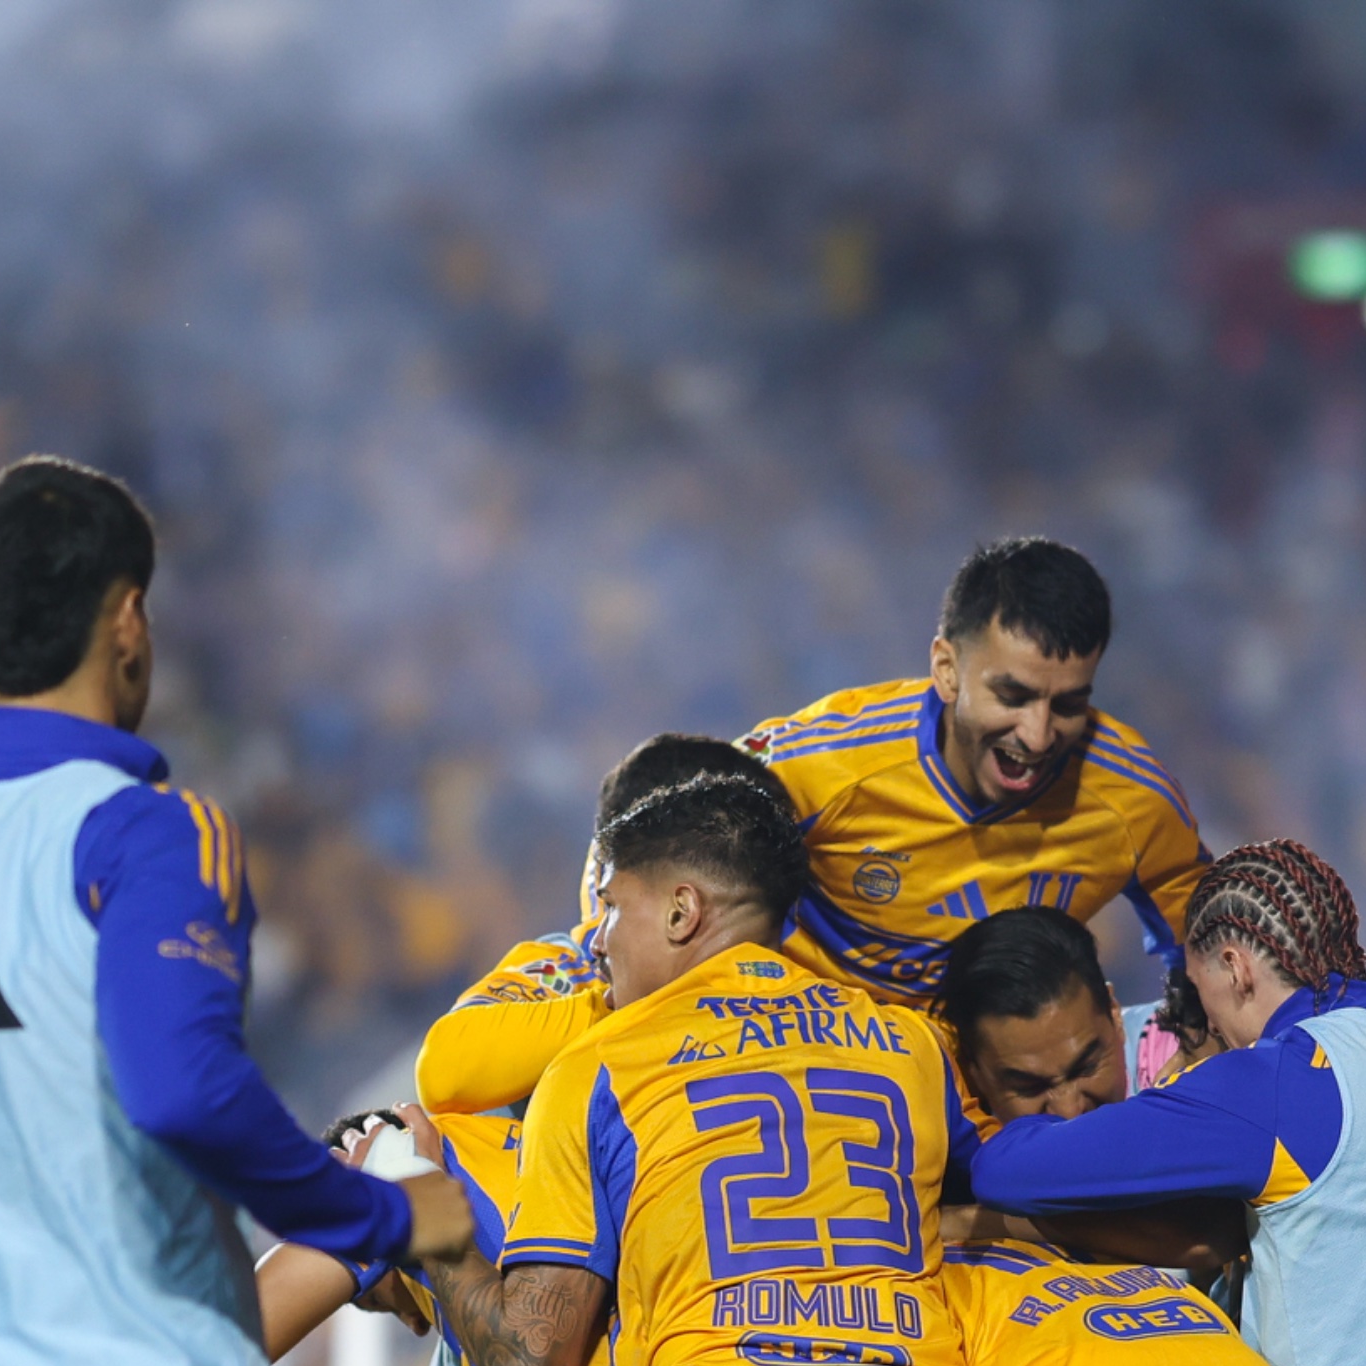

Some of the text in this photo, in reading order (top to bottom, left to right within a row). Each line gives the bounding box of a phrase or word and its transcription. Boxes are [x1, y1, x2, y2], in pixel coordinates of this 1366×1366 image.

[737, 1009, 911, 1055] AFIRME
[686, 1067, 923, 1280] 23
[712, 1278, 923, 1339] ROMULO
